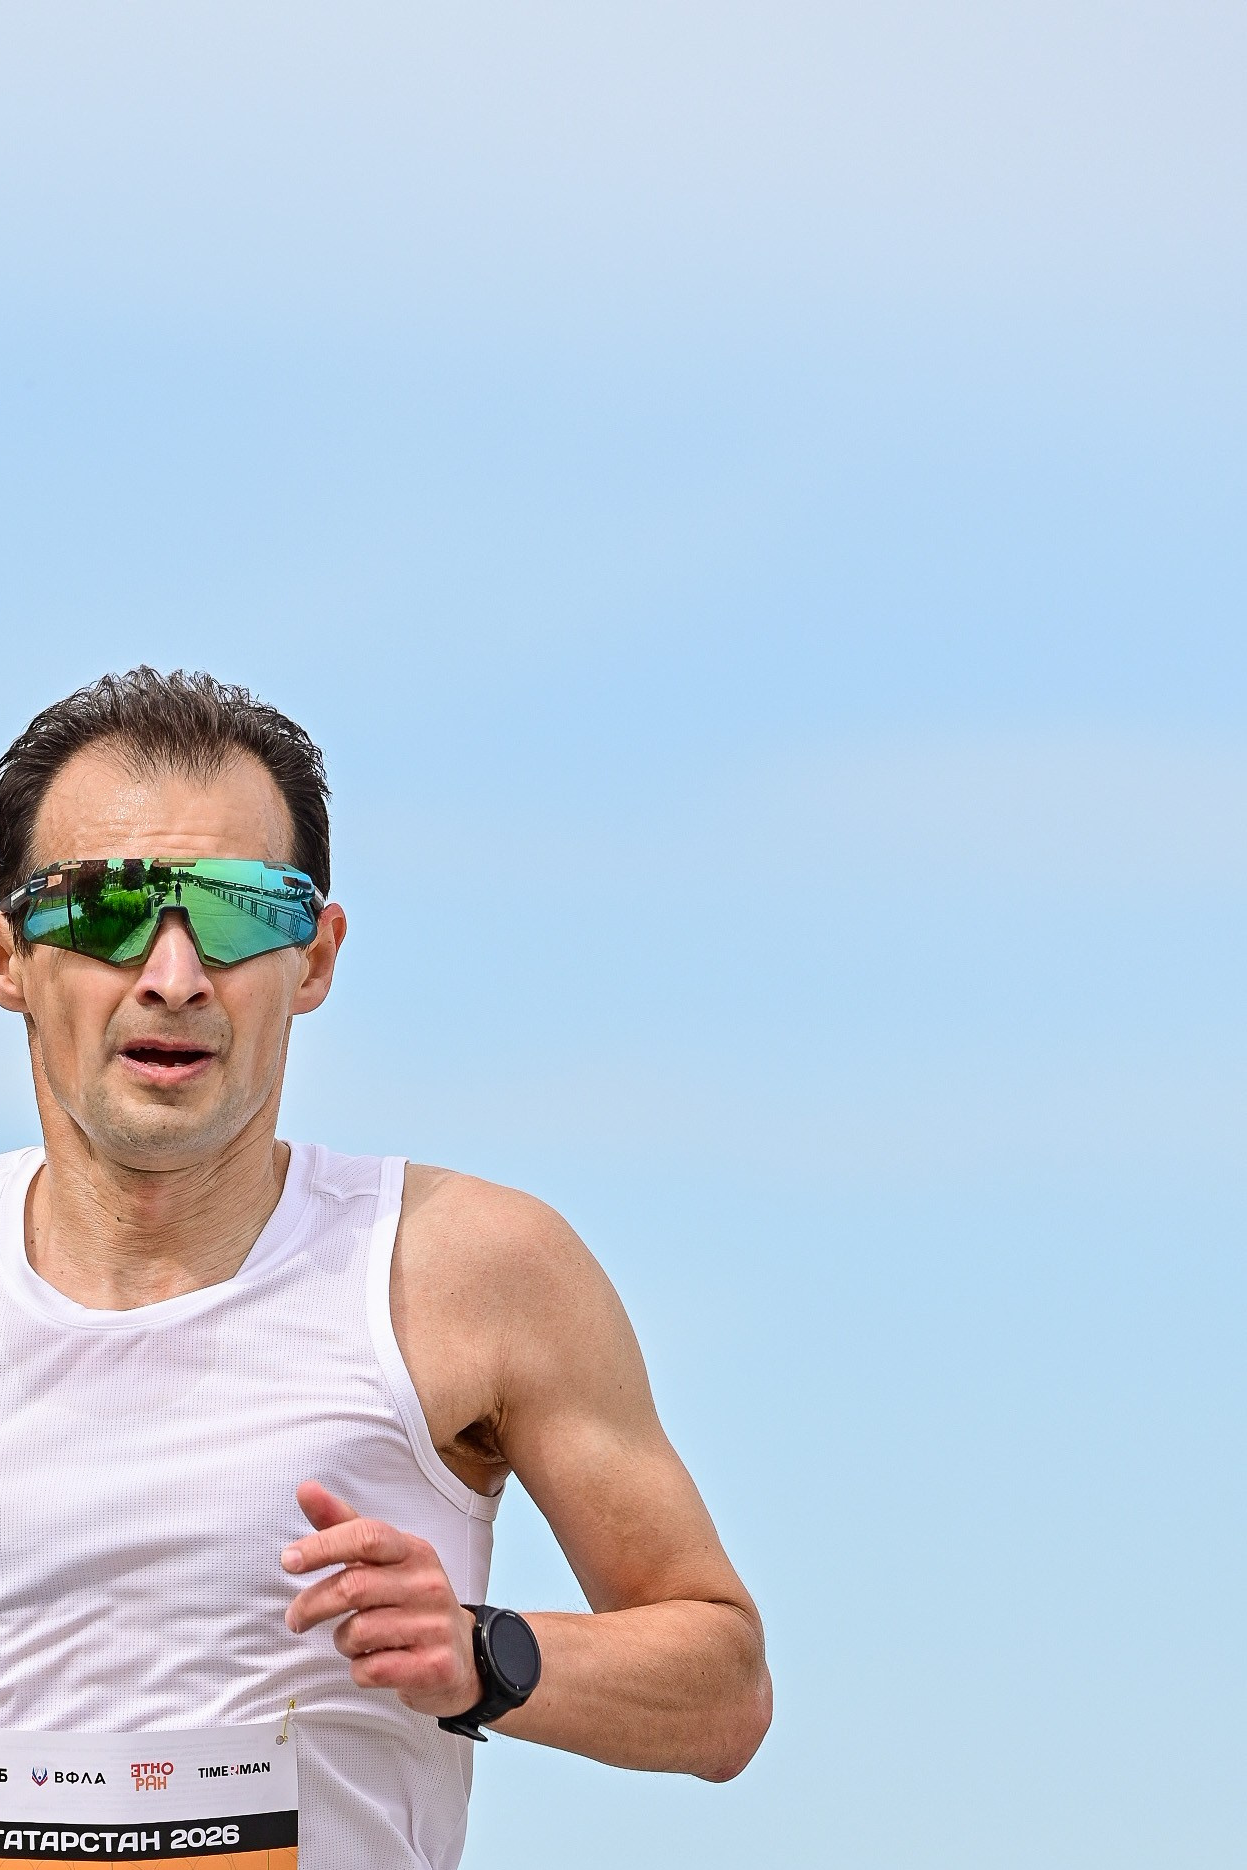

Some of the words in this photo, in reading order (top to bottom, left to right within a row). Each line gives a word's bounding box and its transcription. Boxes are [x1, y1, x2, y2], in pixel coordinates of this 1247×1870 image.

[54, 1770, 106, 1785] ВФЛА
[135, 1775, 167, 1791] РАН
[170, 1824, 241, 1849] 2026
